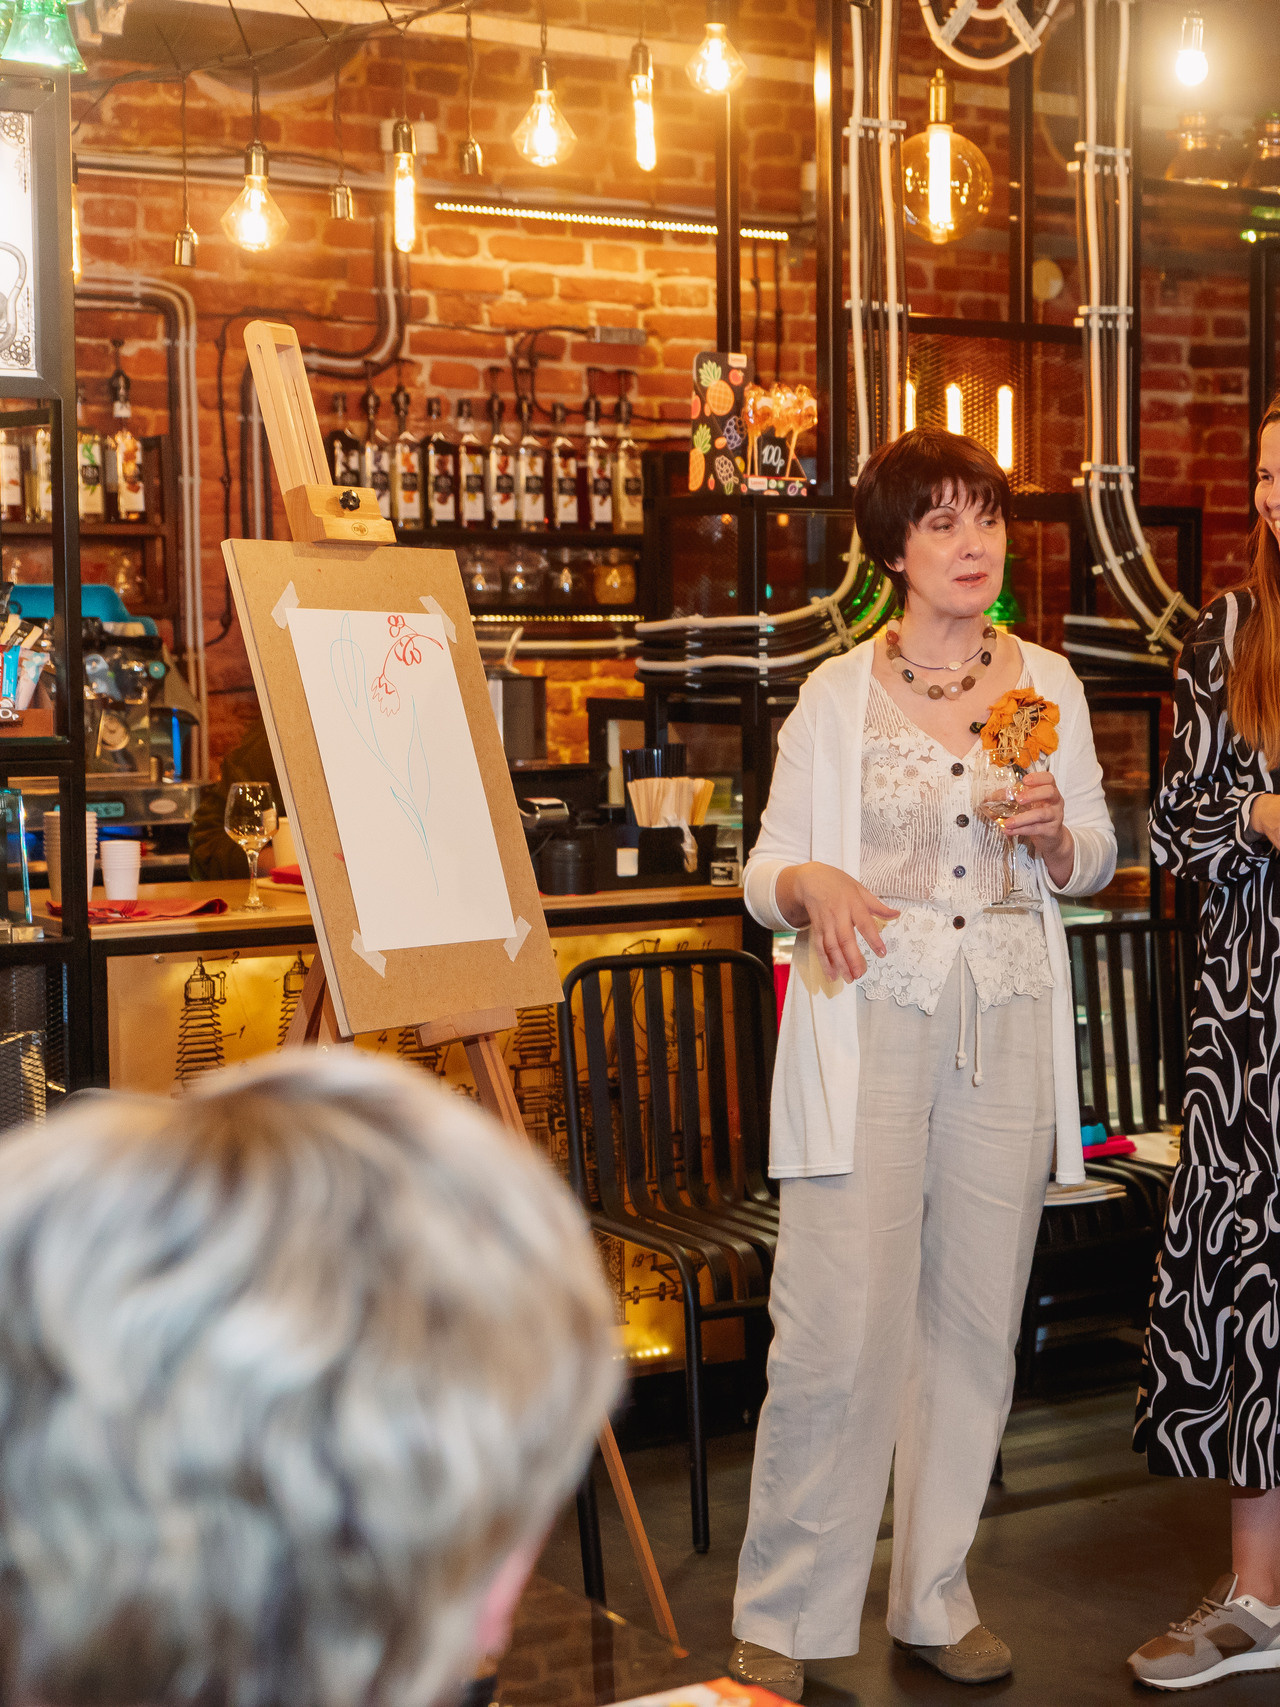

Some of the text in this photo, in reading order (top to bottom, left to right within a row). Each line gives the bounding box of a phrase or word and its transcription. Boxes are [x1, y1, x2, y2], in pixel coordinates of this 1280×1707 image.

[230, 950, 240, 965] 2
[238, 1025, 246, 1040] 1
[377, 1030, 388, 1045] 4
[631, 1253, 645, 1268] 19
